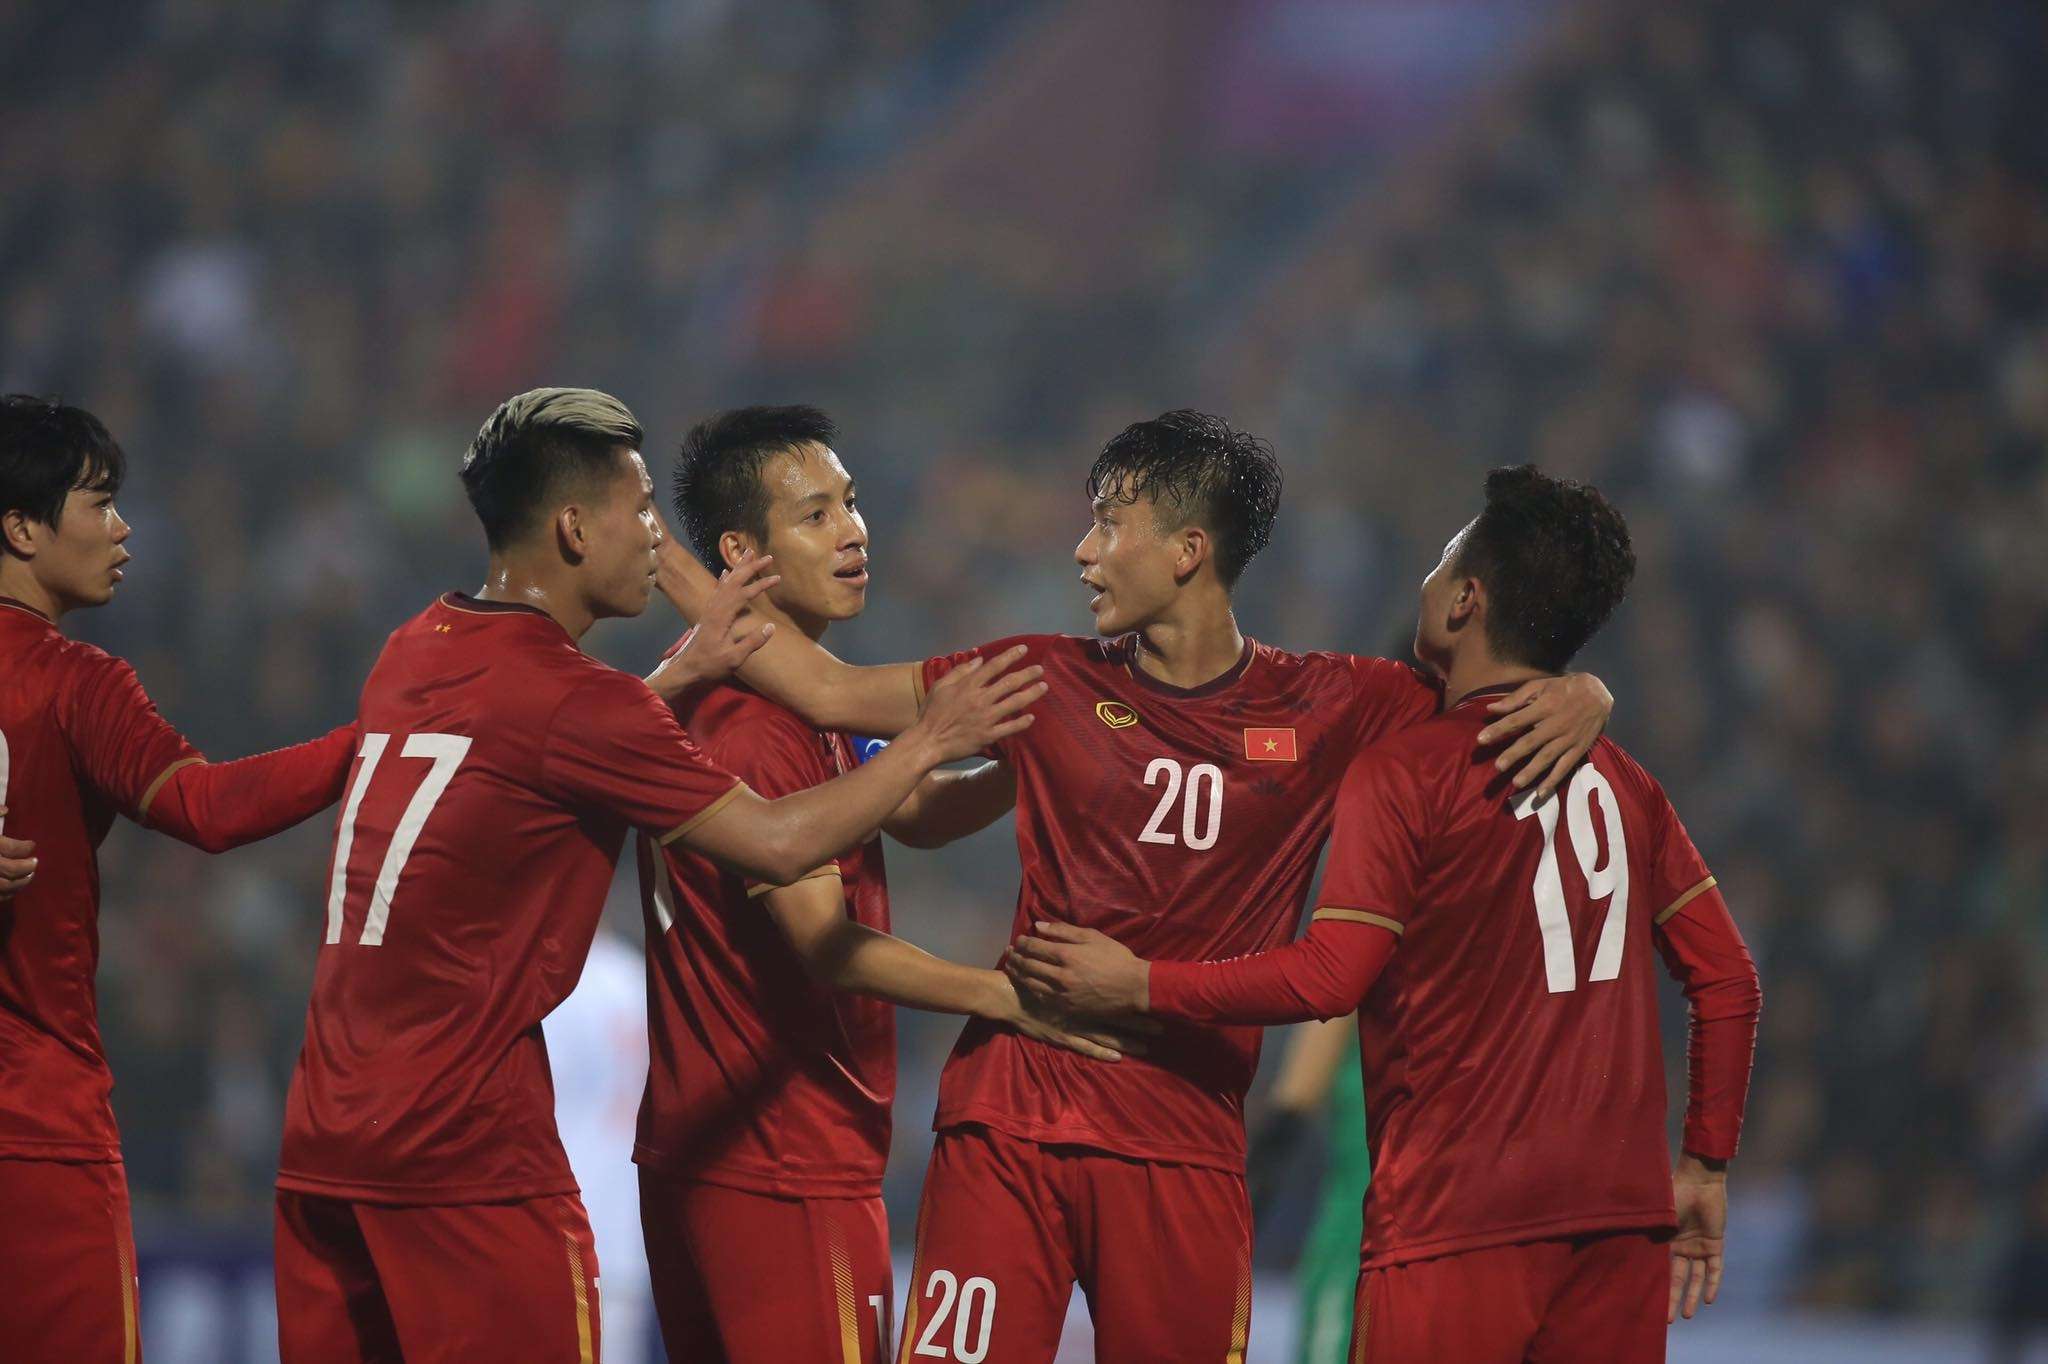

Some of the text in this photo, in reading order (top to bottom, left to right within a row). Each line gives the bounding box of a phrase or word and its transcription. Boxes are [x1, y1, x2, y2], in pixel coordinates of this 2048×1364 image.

[326, 732, 473, 946] 17
[1138, 757, 1224, 851] 20
[1509, 762, 1630, 994] 19
[914, 1269, 997, 1364] 20
